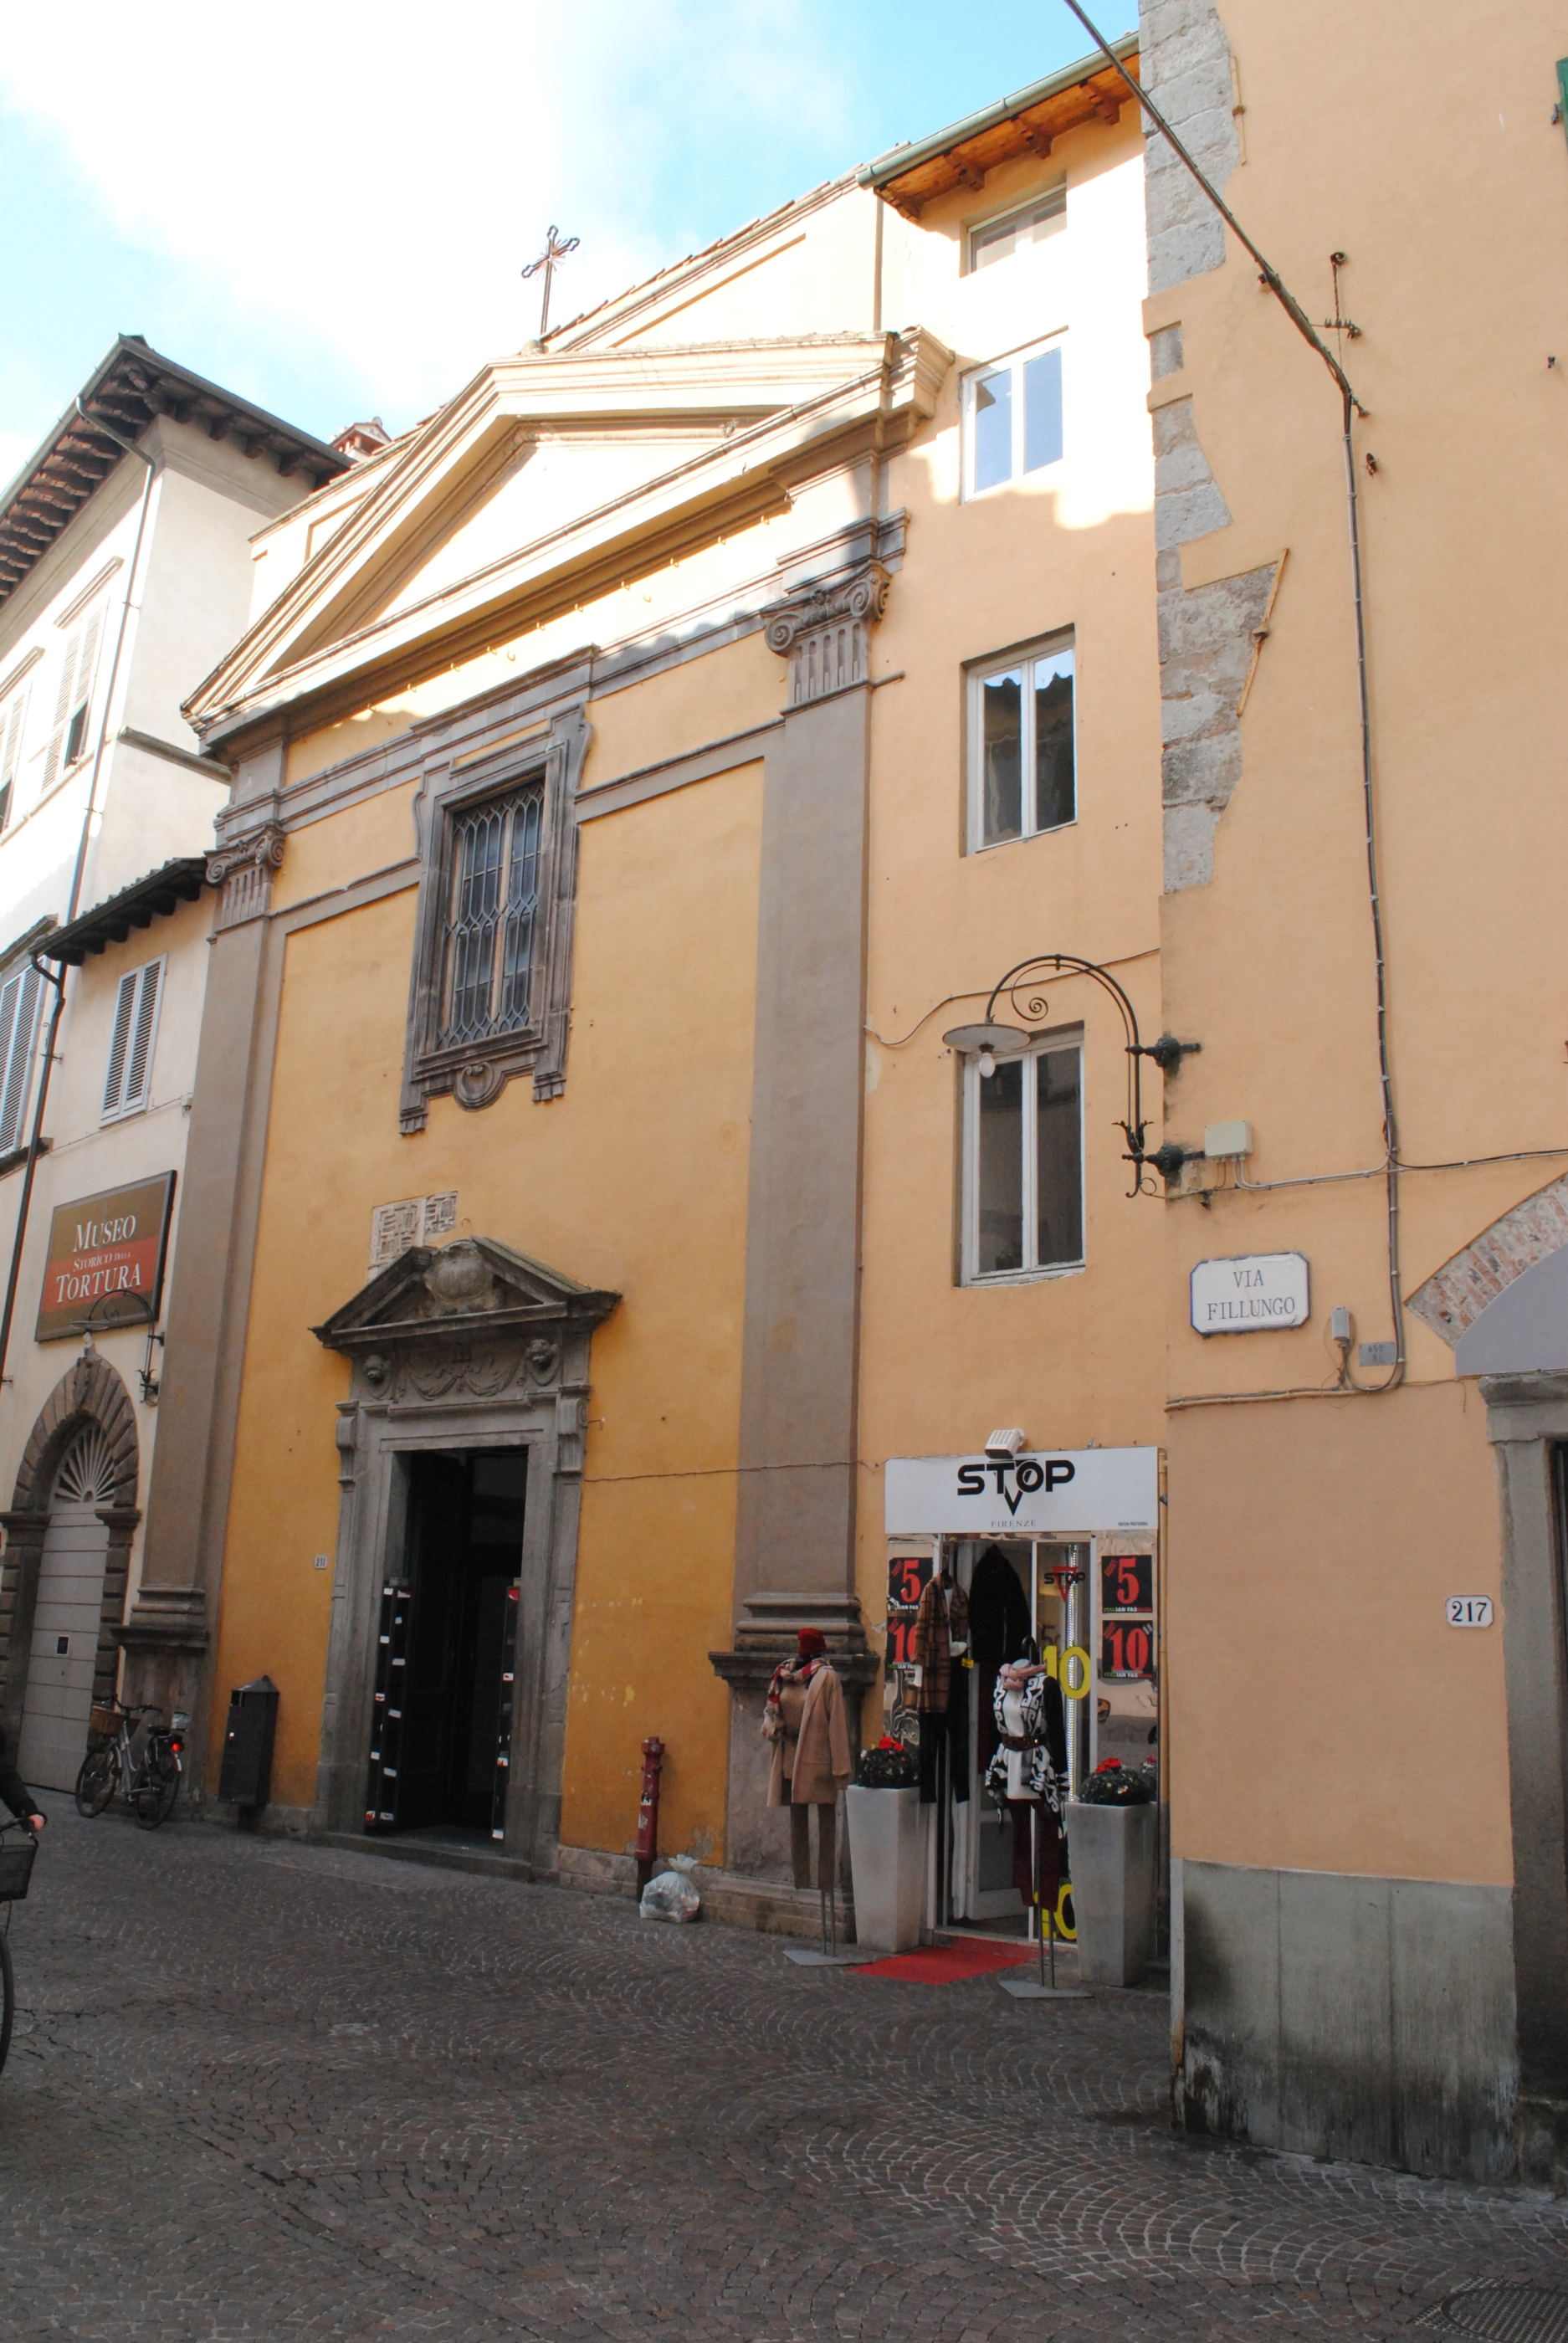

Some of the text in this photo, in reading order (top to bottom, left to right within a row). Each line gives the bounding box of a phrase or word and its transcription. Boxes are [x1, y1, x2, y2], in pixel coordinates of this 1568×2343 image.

[73, 1215, 136, 1253] MUSEO
[73, 1253, 112, 1272] STORICO
[56, 1263, 141, 1303] TORTURA
[1232, 1269, 1264, 1288] VIA
[1207, 1296, 1295, 1320] FILLUNGO
[957, 1459, 1075, 1496] STOP
[991, 1520, 1037, 1528] FIRENZE
[315, 1556, 326, 1567] 211
[901, 1559, 921, 1602] 5
[1043, 1571, 1086, 1585] STOP
[1116, 1556, 1140, 1604] 5
[1452, 1600, 1488, 1623] 217
[1109, 1628, 1149, 1671] 10
[1043, 1644, 1091, 1700] 10
